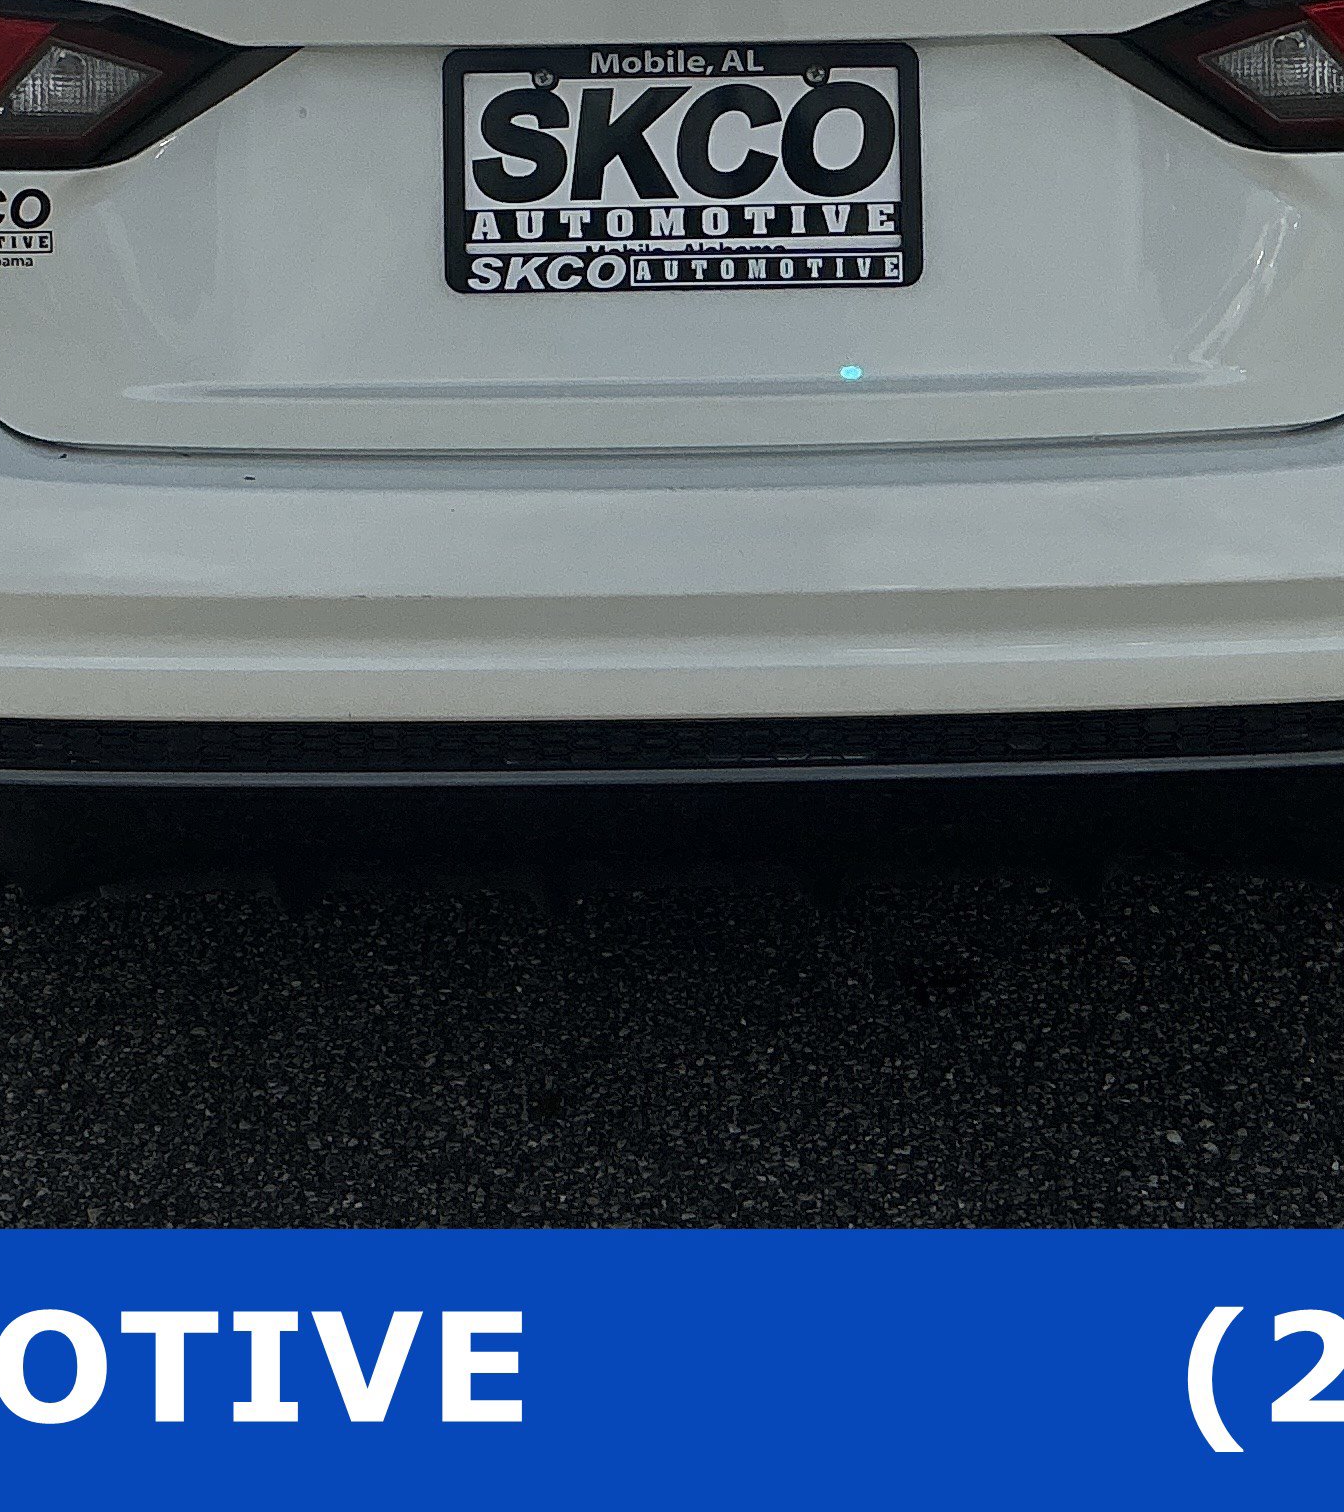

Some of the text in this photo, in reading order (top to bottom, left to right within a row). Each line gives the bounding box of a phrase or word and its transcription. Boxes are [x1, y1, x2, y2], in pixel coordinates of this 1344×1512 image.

[590, 50, 765, 76] Mobile, AL
[472, 81, 896, 204] SKCO
[472, 204, 895, 240] AUTOMOTIVE
[467, 255, 900, 290] SKCO AUTOMOTIVE
